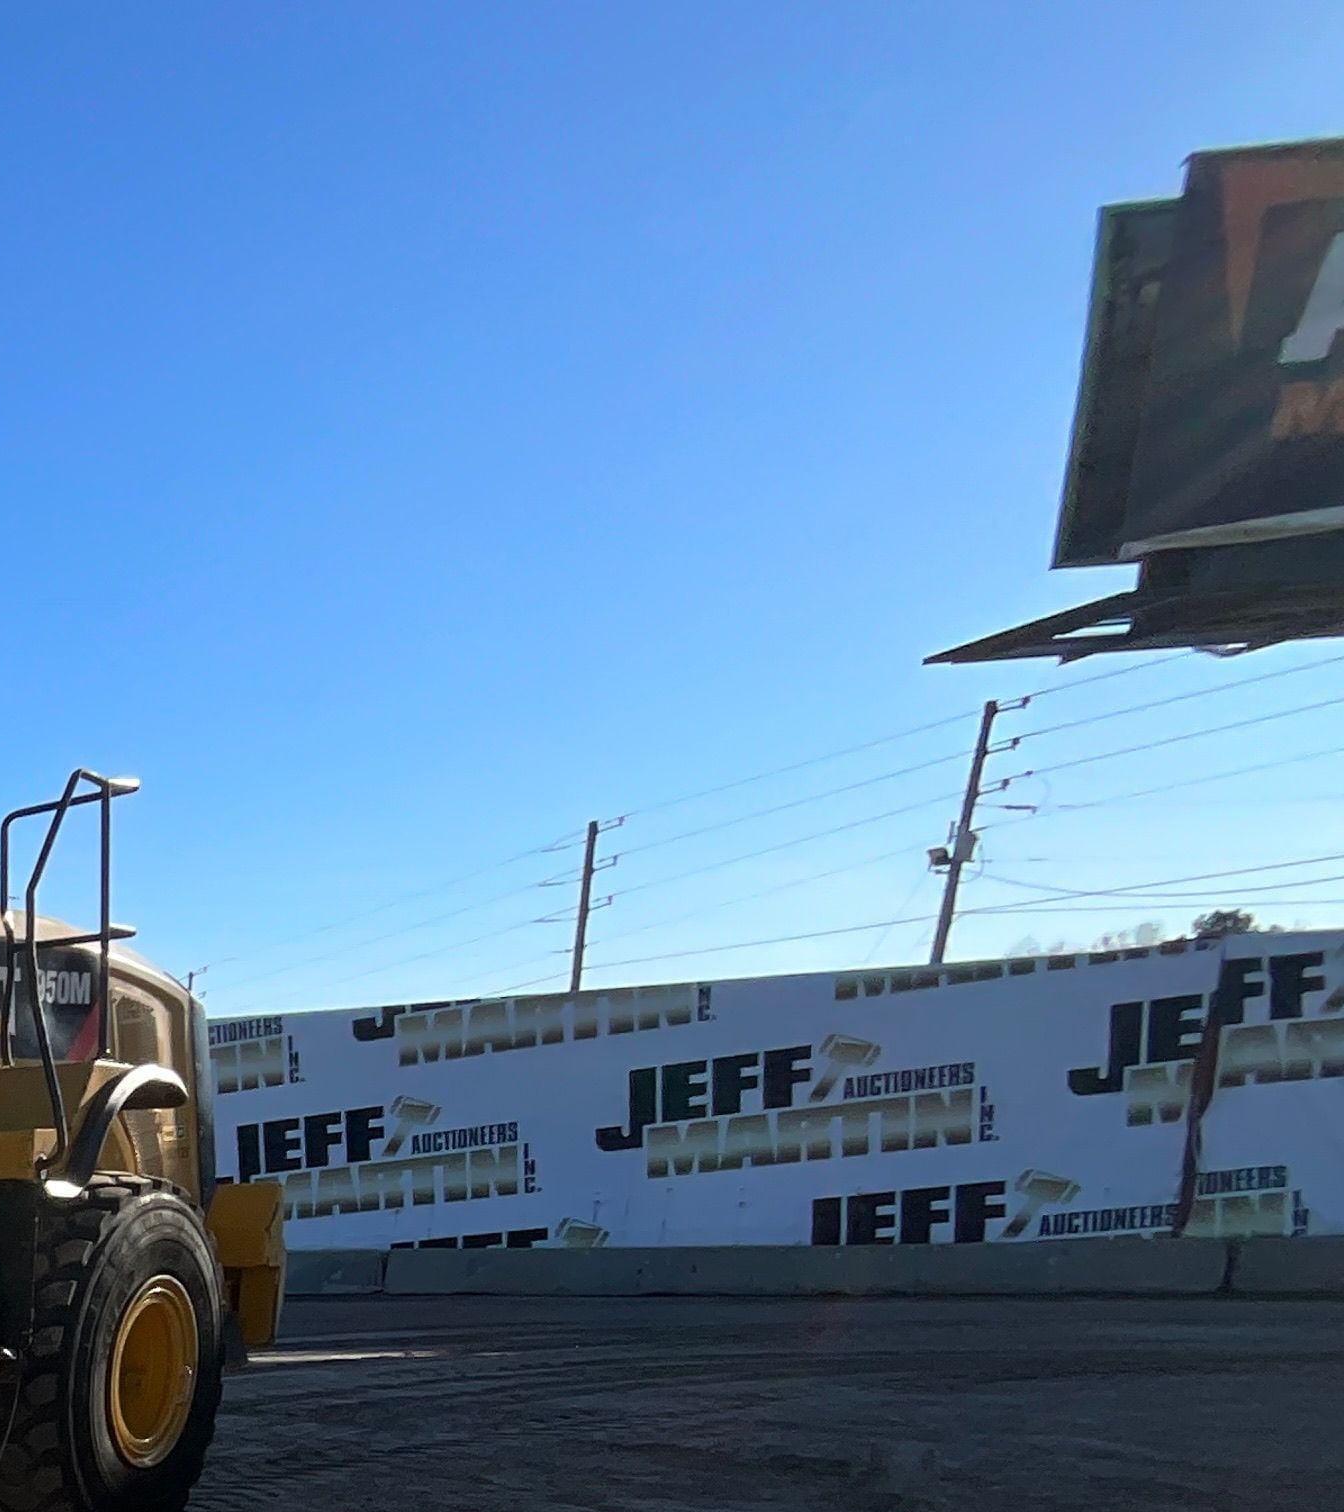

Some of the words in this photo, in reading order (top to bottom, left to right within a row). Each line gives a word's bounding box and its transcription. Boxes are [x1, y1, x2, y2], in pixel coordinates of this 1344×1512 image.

[698, 986, 717, 1022] NC.
[1066, 951, 1326, 1096] JEFF
[208, 1016, 283, 1046] CTIONEERS
[595, 1045, 812, 1151] JEFF
[843, 1062, 976, 1099] AUCTIONEERS
[647, 1087, 973, 1179] MARTIN
[979, 1086, 1000, 1142] INC.
[413, 1121, 519, 1154] AUCTIONEERS
[523, 1142, 543, 1194] INC.
[1039, 1203, 1180, 1237] AUCTIONEERS
